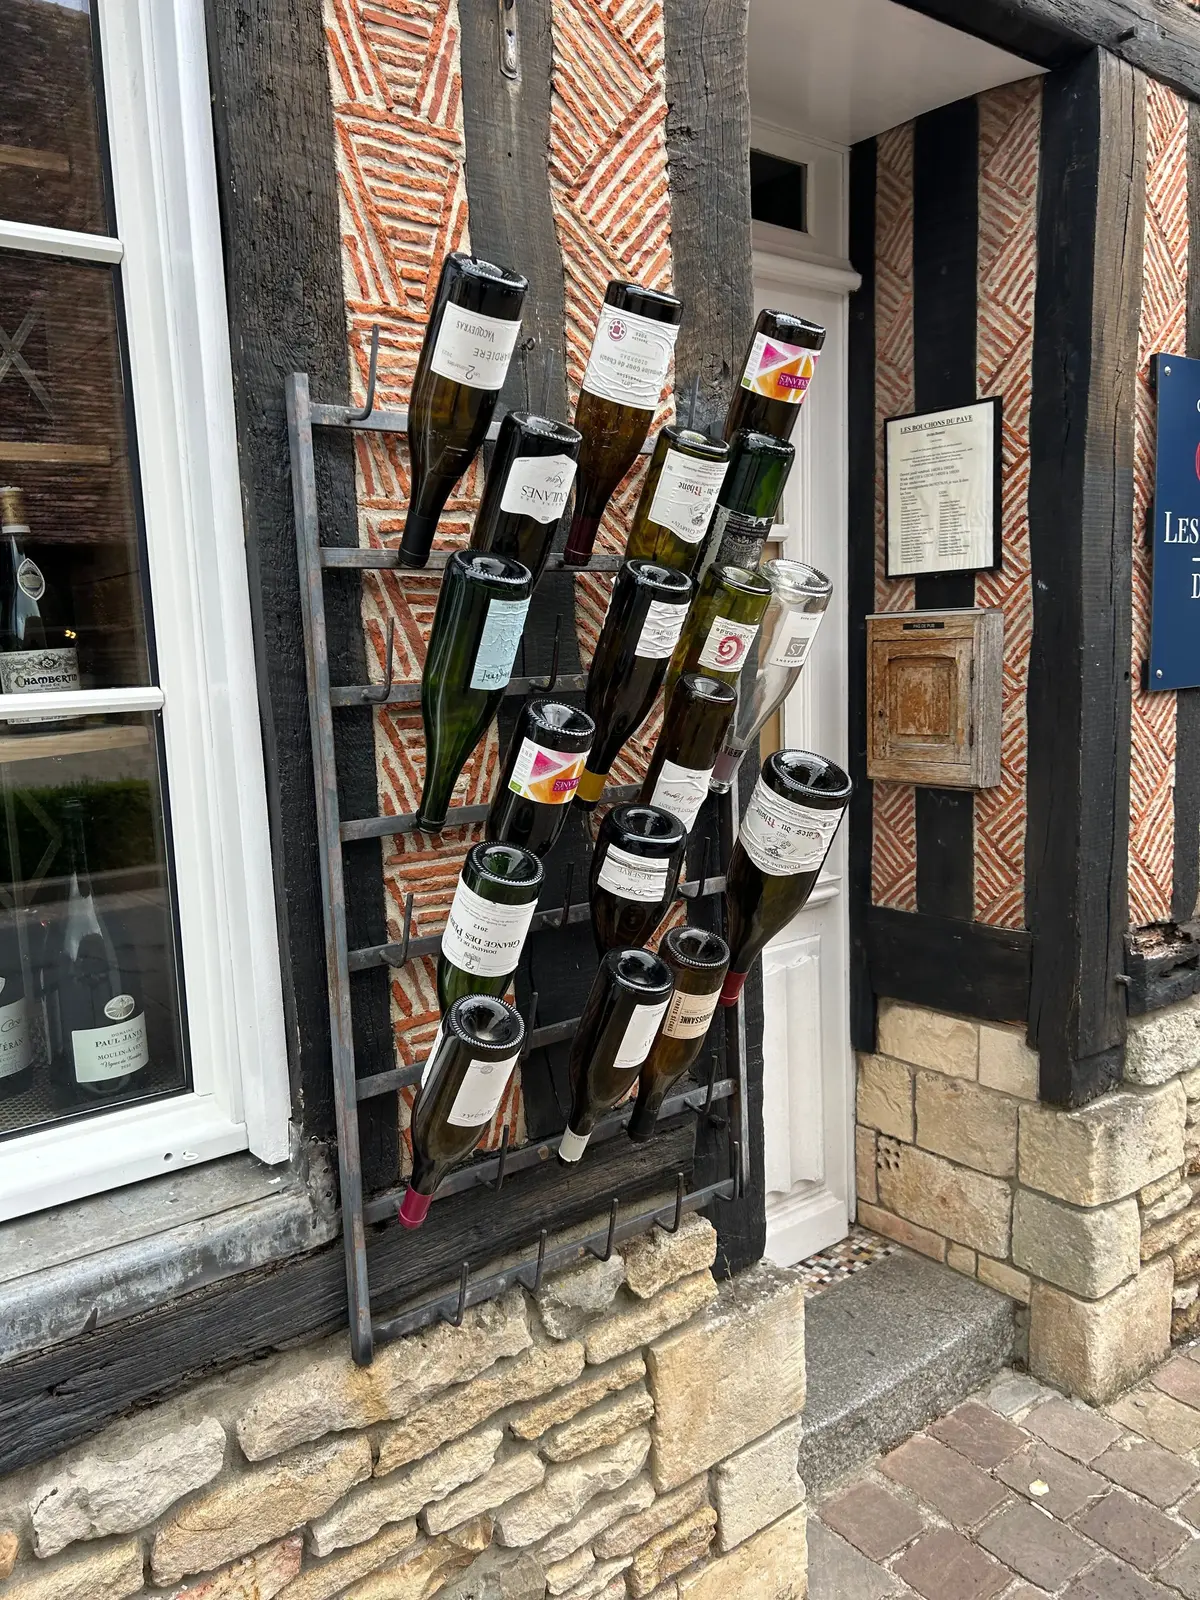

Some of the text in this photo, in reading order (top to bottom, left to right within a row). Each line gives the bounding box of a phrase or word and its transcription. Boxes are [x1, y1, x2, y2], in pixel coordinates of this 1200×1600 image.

[455, 320, 495, 342] VACQUEYRAS
[472, 347, 510, 363] ARDIÈRE
[900, 425, 913, 433] LES
[912, 419, 945, 431] BOUCHONS
[1164, 511, 1200, 544] LES
[472, 923, 488, 932] 2012
[464, 932, 481, 944] DES
[483, 939, 520, 949] GRANGE
[470, 943, 497, 954] DOMAINE
[679, 1012, 711, 1023] OUSSANNE
[0, 1038, 23, 1051] ÉRAN
[95, 1037, 120, 1047] PAUL
